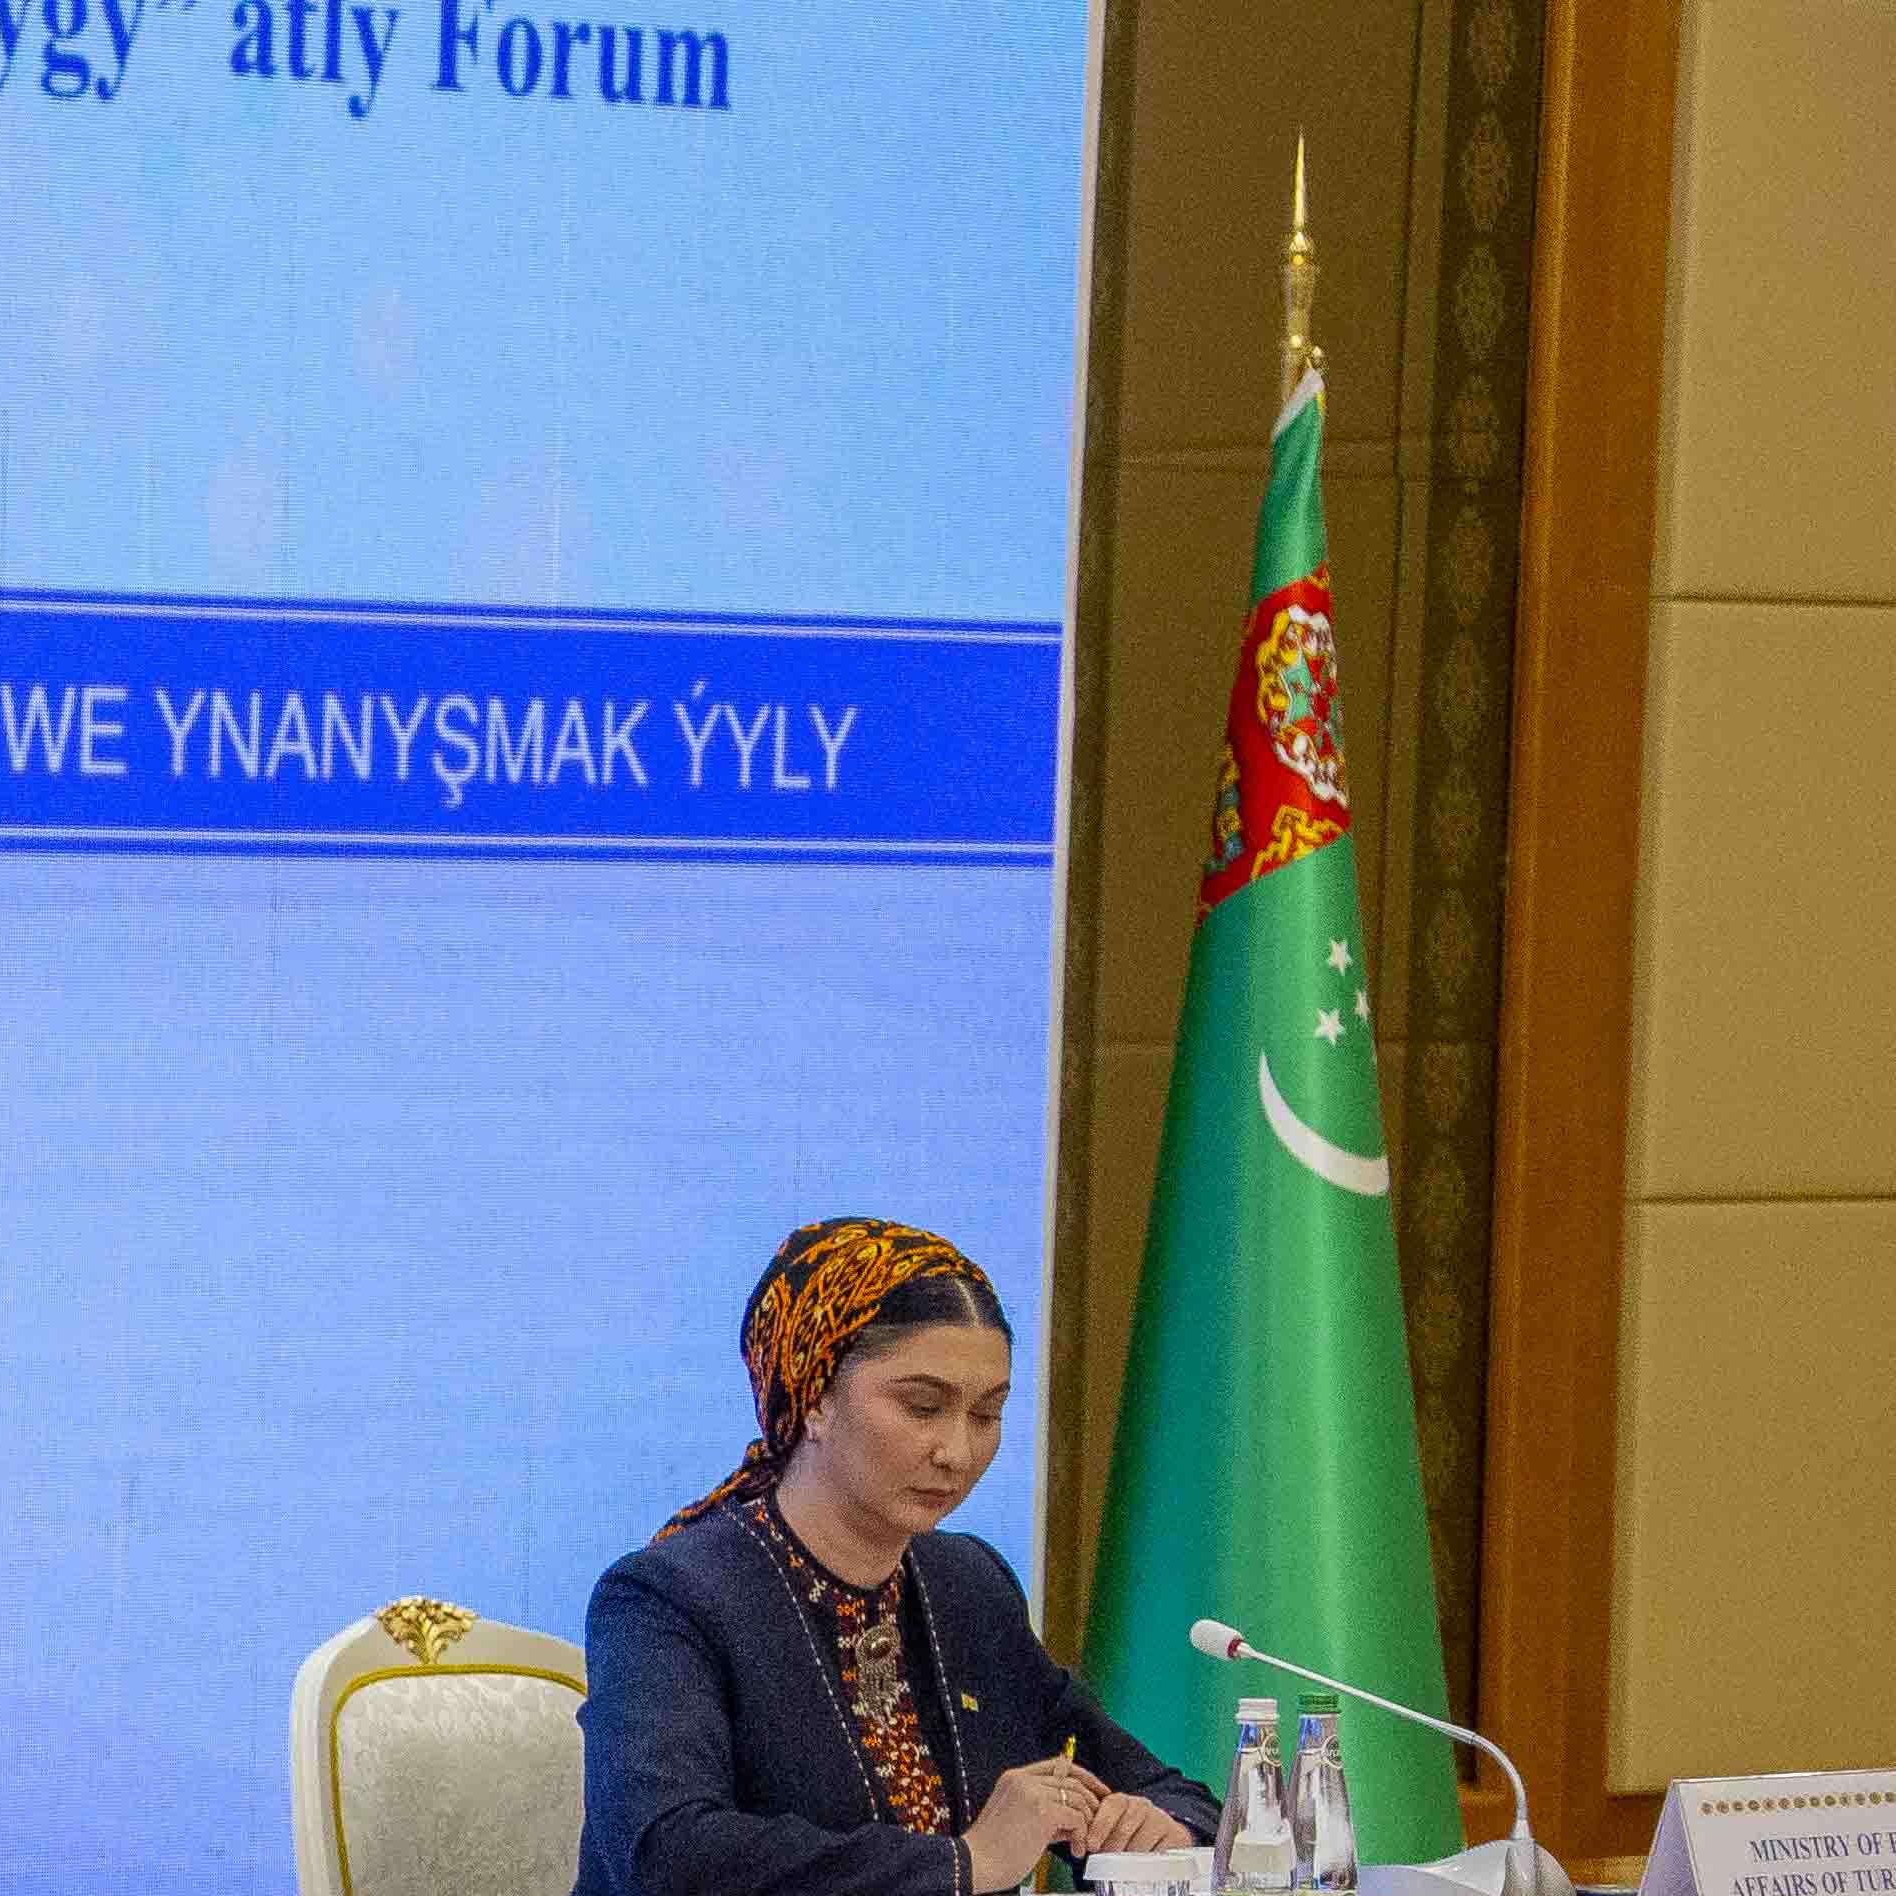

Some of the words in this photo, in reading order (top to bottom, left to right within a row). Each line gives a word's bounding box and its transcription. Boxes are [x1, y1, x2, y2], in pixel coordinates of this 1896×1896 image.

[227, 0, 401, 120] atly
[430, 0, 732, 112] Forum
[0, 684, 128, 777] WE
[154, 688, 649, 806] YNANYŞMAK
[673, 680, 859, 790] ÝYLY
[1750, 1834, 1850, 1863] MINISTRY
[1857, 1831, 1883, 1856] OF
[1822, 1870, 1848, 1895] OF
[1854, 1866, 1896, 1893] TUR
